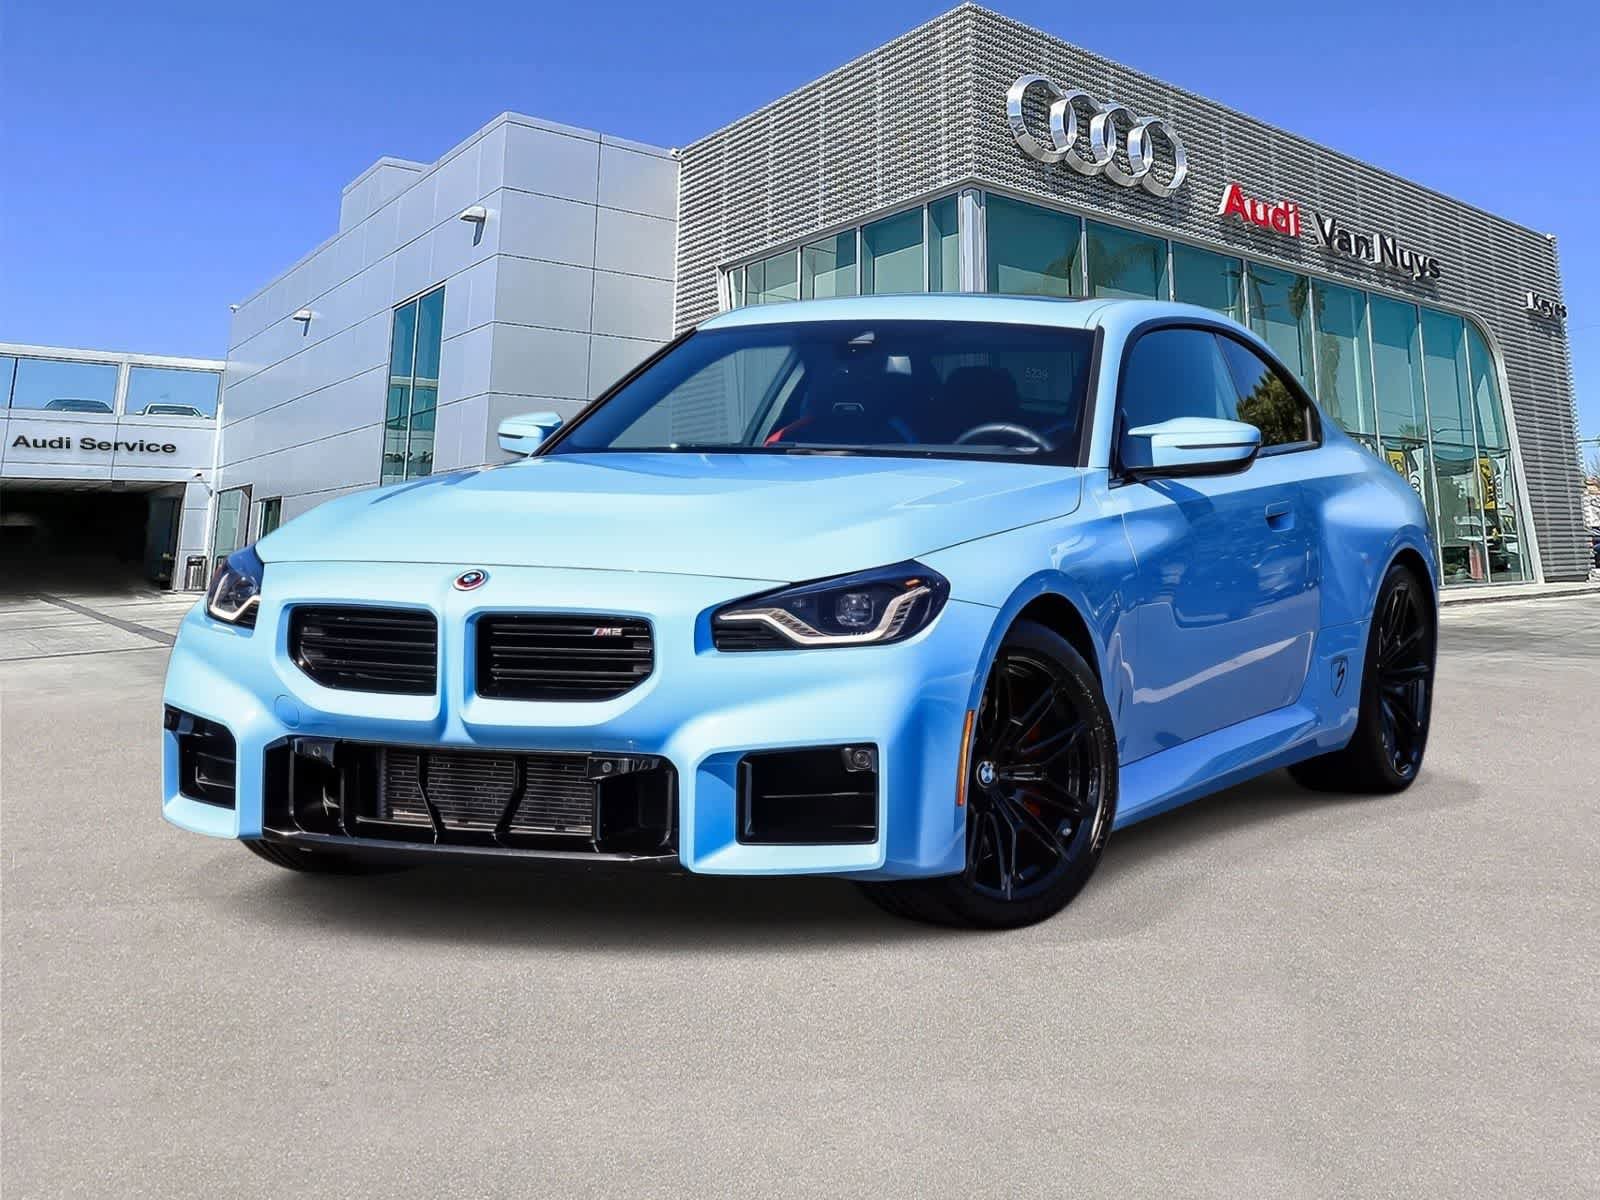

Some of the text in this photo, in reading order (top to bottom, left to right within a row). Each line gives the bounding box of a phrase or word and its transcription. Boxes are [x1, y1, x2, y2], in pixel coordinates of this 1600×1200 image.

[1219, 183, 1441, 280] Audi Van Nuys
[1527, 292, 1568, 320] Keyes
[12, 435, 177, 453] Audi Service
